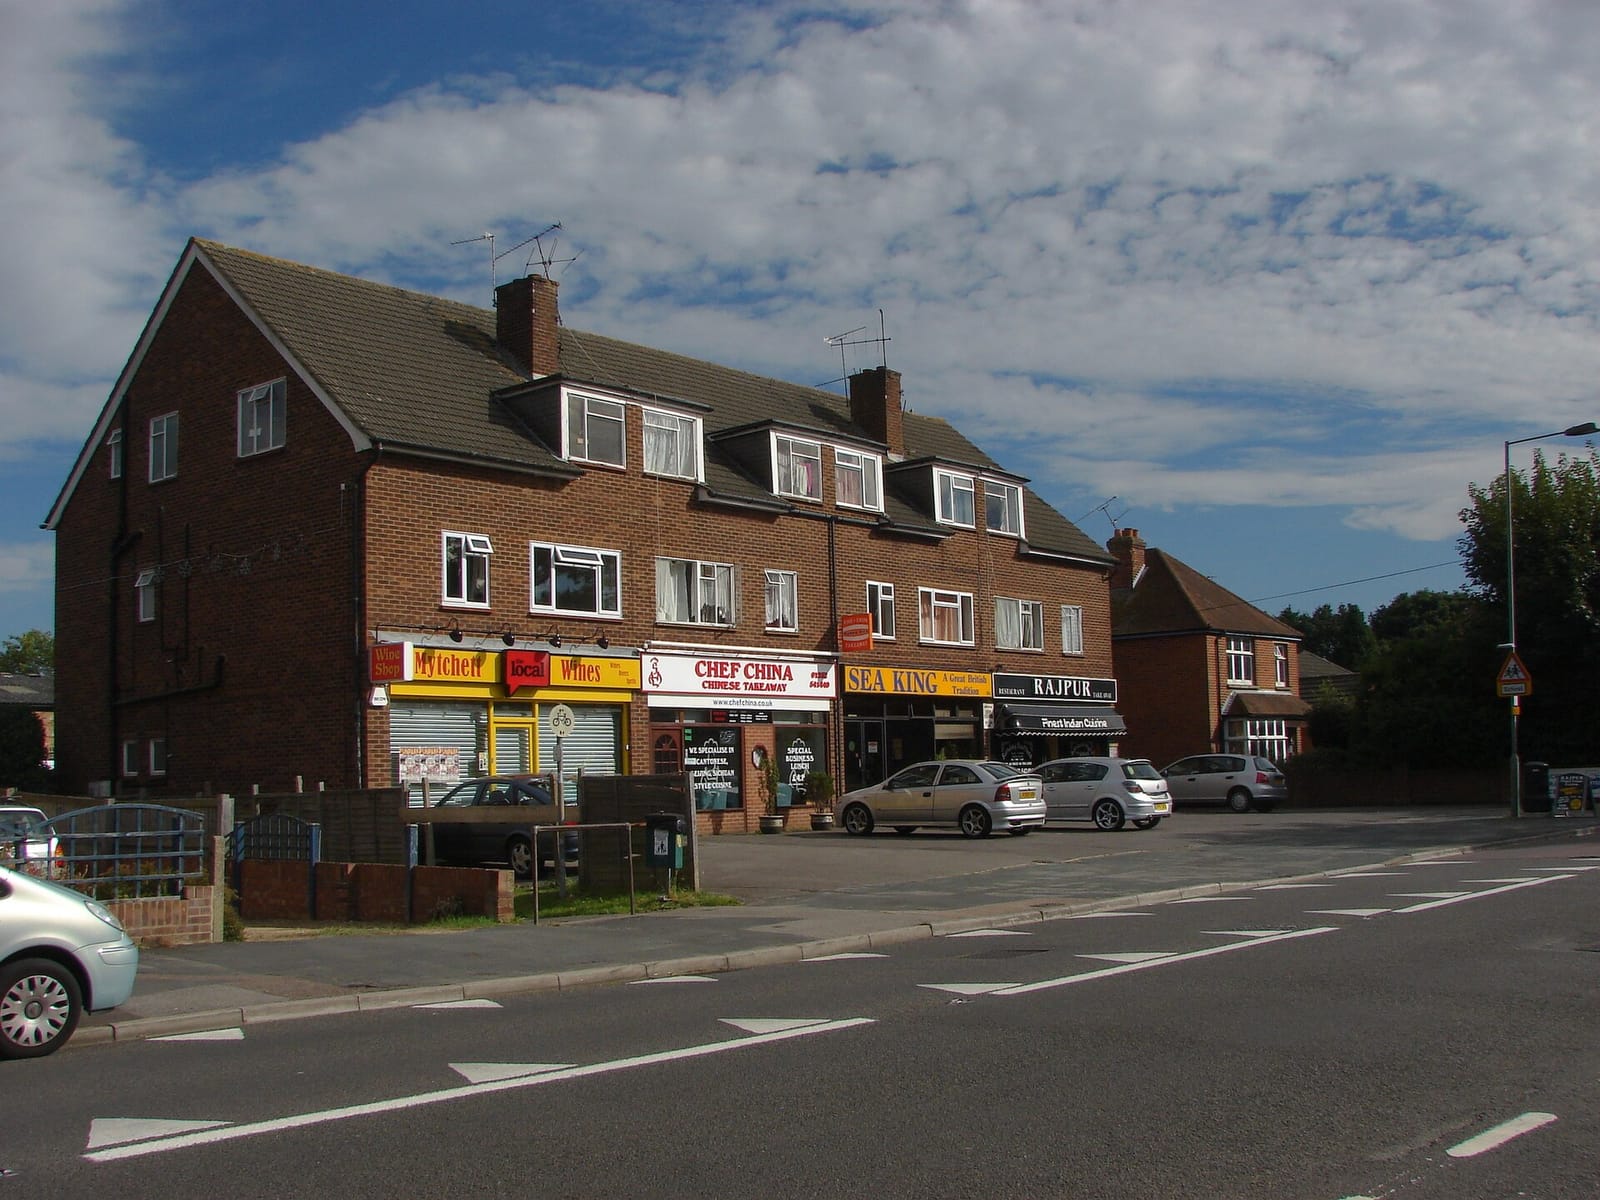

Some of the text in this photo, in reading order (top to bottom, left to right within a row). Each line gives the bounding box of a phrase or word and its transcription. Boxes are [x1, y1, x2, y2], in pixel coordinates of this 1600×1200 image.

[375, 648, 400, 660] Wine
[375, 663, 400, 676] Shop
[415, 652, 482, 677] Mytchett
[511, 661, 544, 677] local
[561, 659, 601, 682] Wines
[694, 660, 794, 681] CHEF CHINA
[848, 668, 938, 694] SEA KING
[943, 673, 987, 684] A Great British
[702, 680, 788, 692] CHINESE TAKEAWAY
[952, 686, 979, 695] Tradition
[998, 687, 1025, 696] RESTAURANT
[1034, 678, 1092, 697] RAJPUR
[713, 699, 773, 707] www.chefchina.co.uk
[1041, 718, 1108, 728] Finest Indian Cuisine
[790, 762, 810, 770] LUNCH
